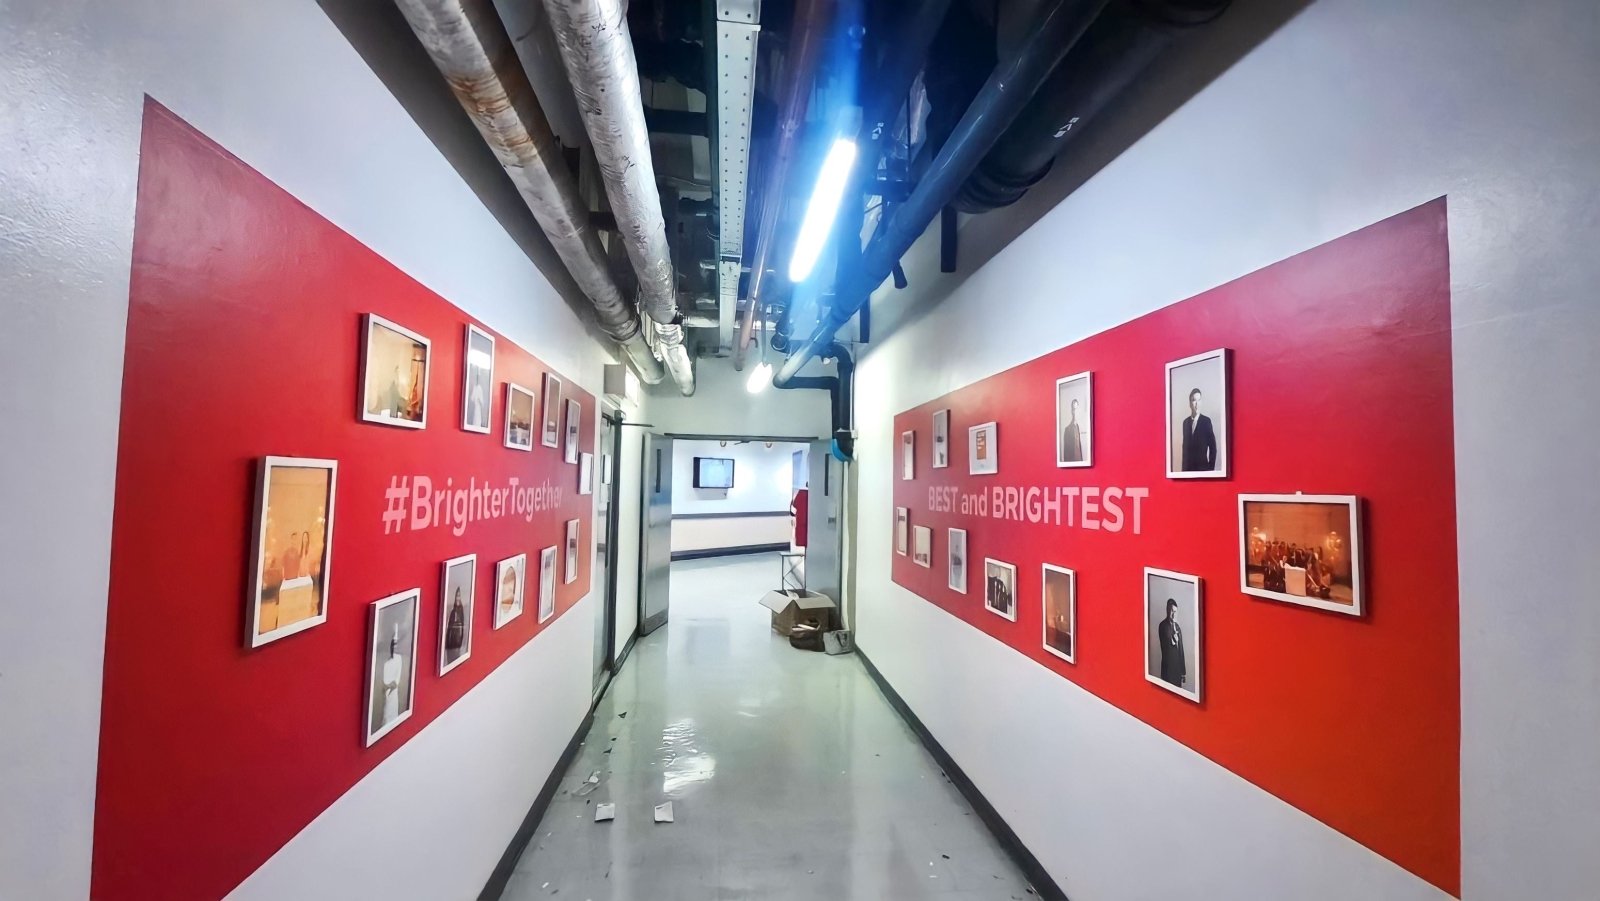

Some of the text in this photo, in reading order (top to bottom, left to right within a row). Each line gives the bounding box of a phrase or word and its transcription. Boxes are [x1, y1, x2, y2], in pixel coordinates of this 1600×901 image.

[382, 475, 562, 536] #BrighterTogether
[928, 486, 1149, 535] BEST and BRIGHTEST
